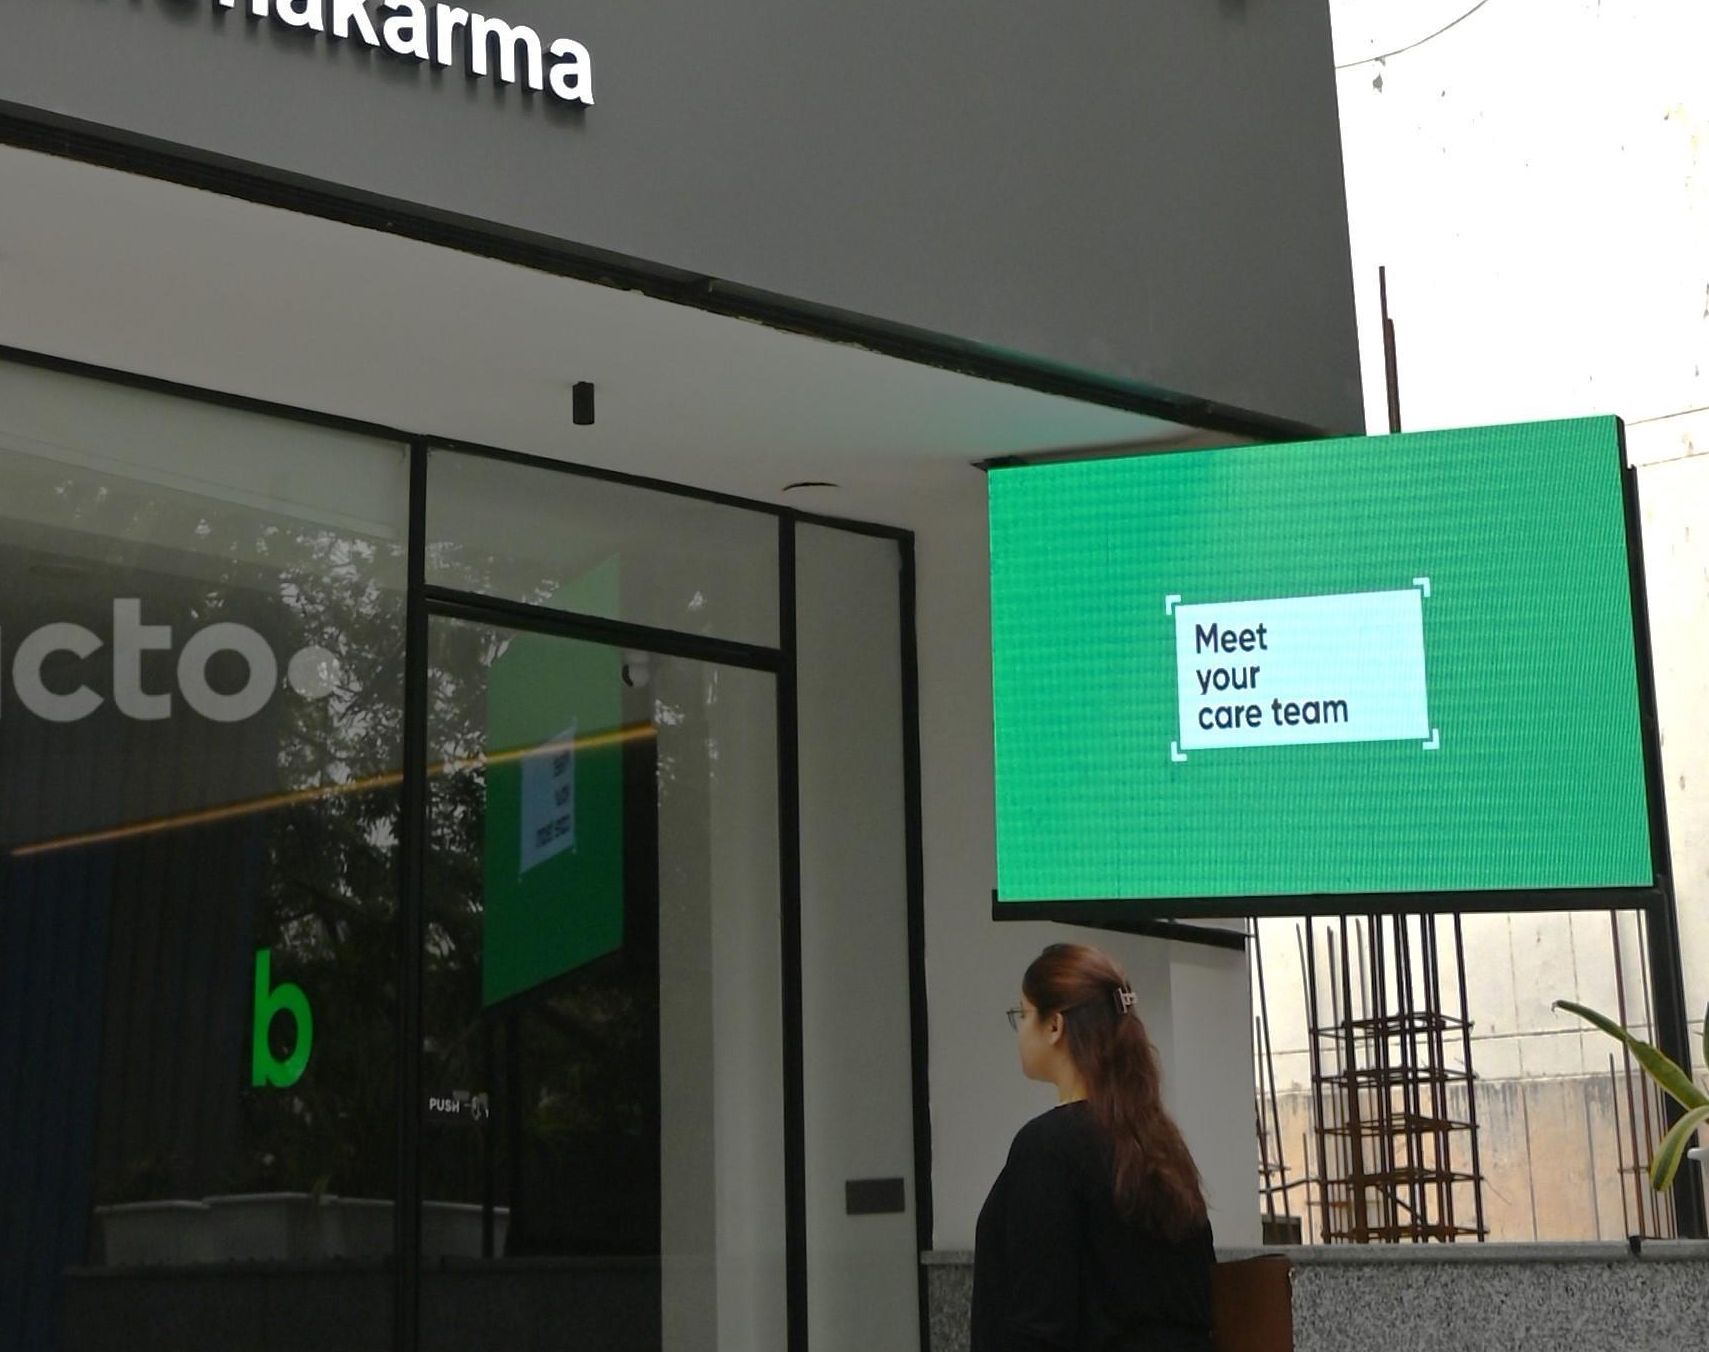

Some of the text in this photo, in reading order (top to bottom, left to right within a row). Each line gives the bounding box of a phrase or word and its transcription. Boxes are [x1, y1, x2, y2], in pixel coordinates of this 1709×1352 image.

[1194, 622, 1268, 655] Meet
[1195, 665, 1261, 696] your
[1198, 697, 1349, 731] care team
[250, 948, 314, 1088] b
[428, 1096, 461, 1115] PUSH
